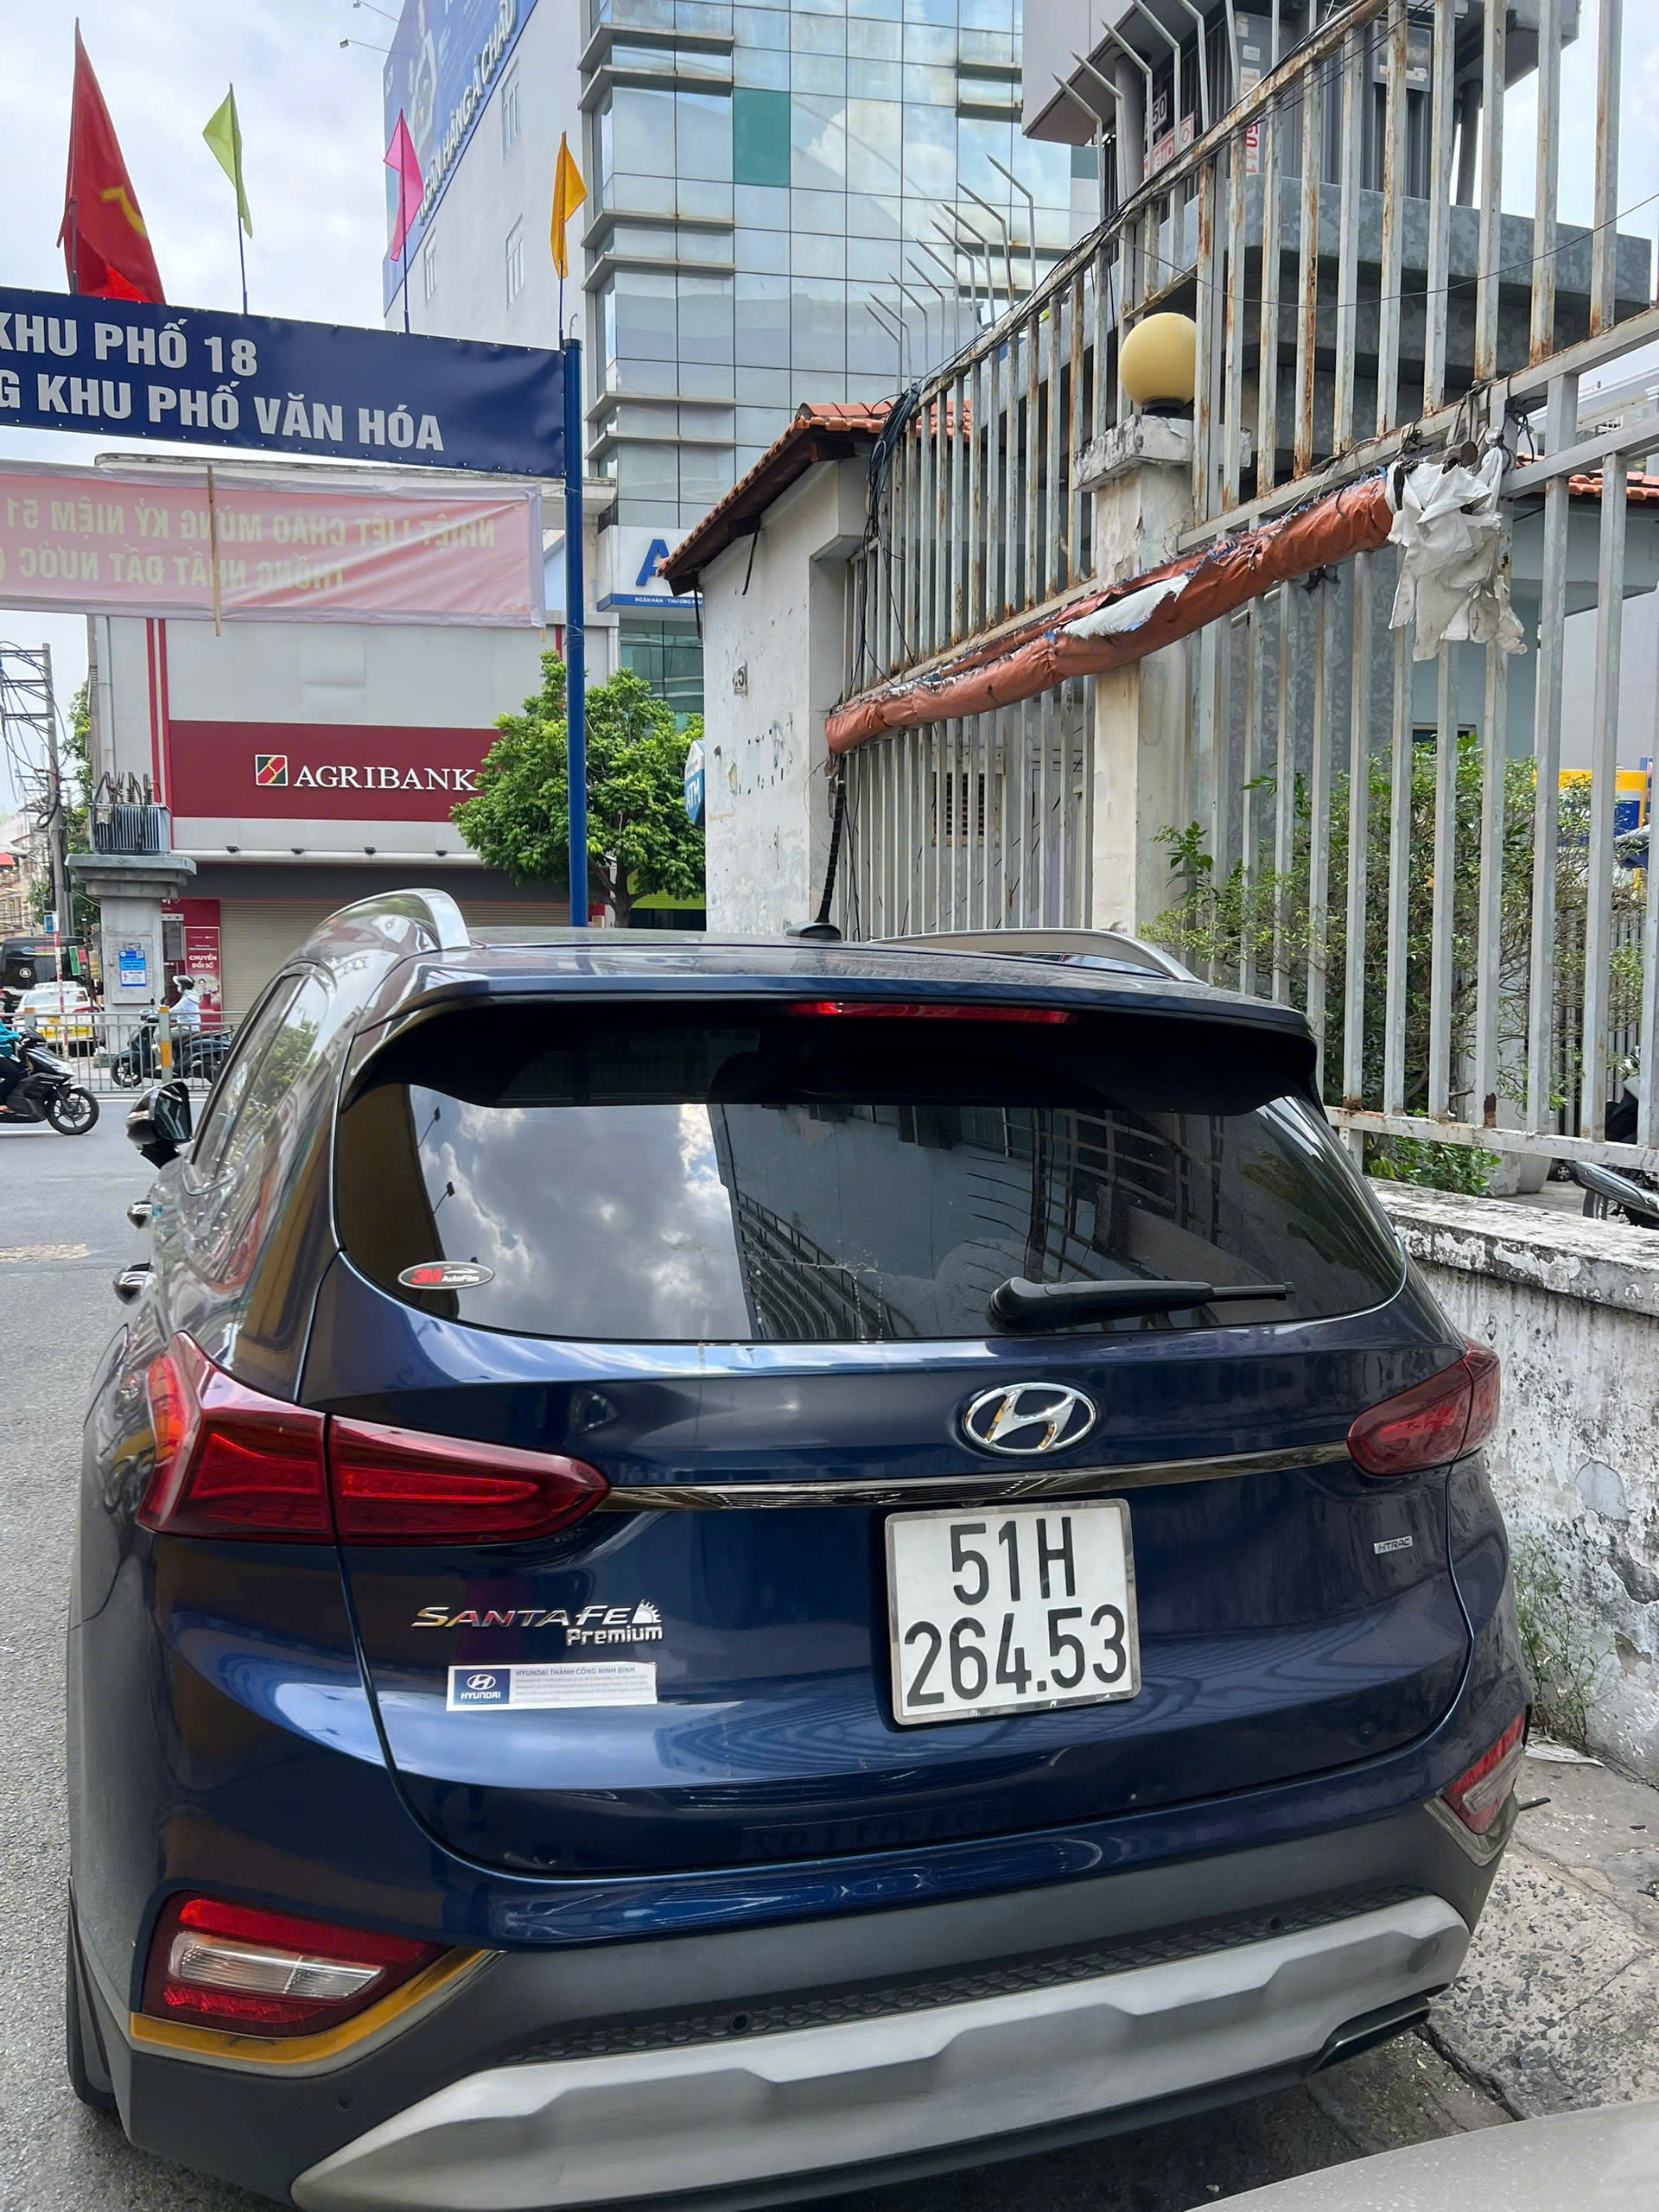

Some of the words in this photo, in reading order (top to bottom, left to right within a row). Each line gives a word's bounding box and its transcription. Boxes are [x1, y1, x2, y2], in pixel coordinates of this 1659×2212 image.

[94, 319, 188, 369] PHỐ
[204, 336, 257, 377] 18
[37, 373, 131, 420] KHU
[148, 380, 240, 430] PHỐ
[253, 392, 343, 442] VĂN
[358, 404, 444, 451] HÓA
[293, 765, 479, 791] AGRIBANK
[411, 1268, 443, 1285] 3M
[1377, 1538, 1411, 1553] HTRAC
[950, 1516, 1076, 1605] 51H
[410, 1606, 569, 1628] SANTA
[575, 1605, 632, 1626] FE
[566, 1625, 663, 1646] Premium
[905, 1604, 1126, 1707] 264.53
[461, 1691, 501, 1700] HYUNDAI
